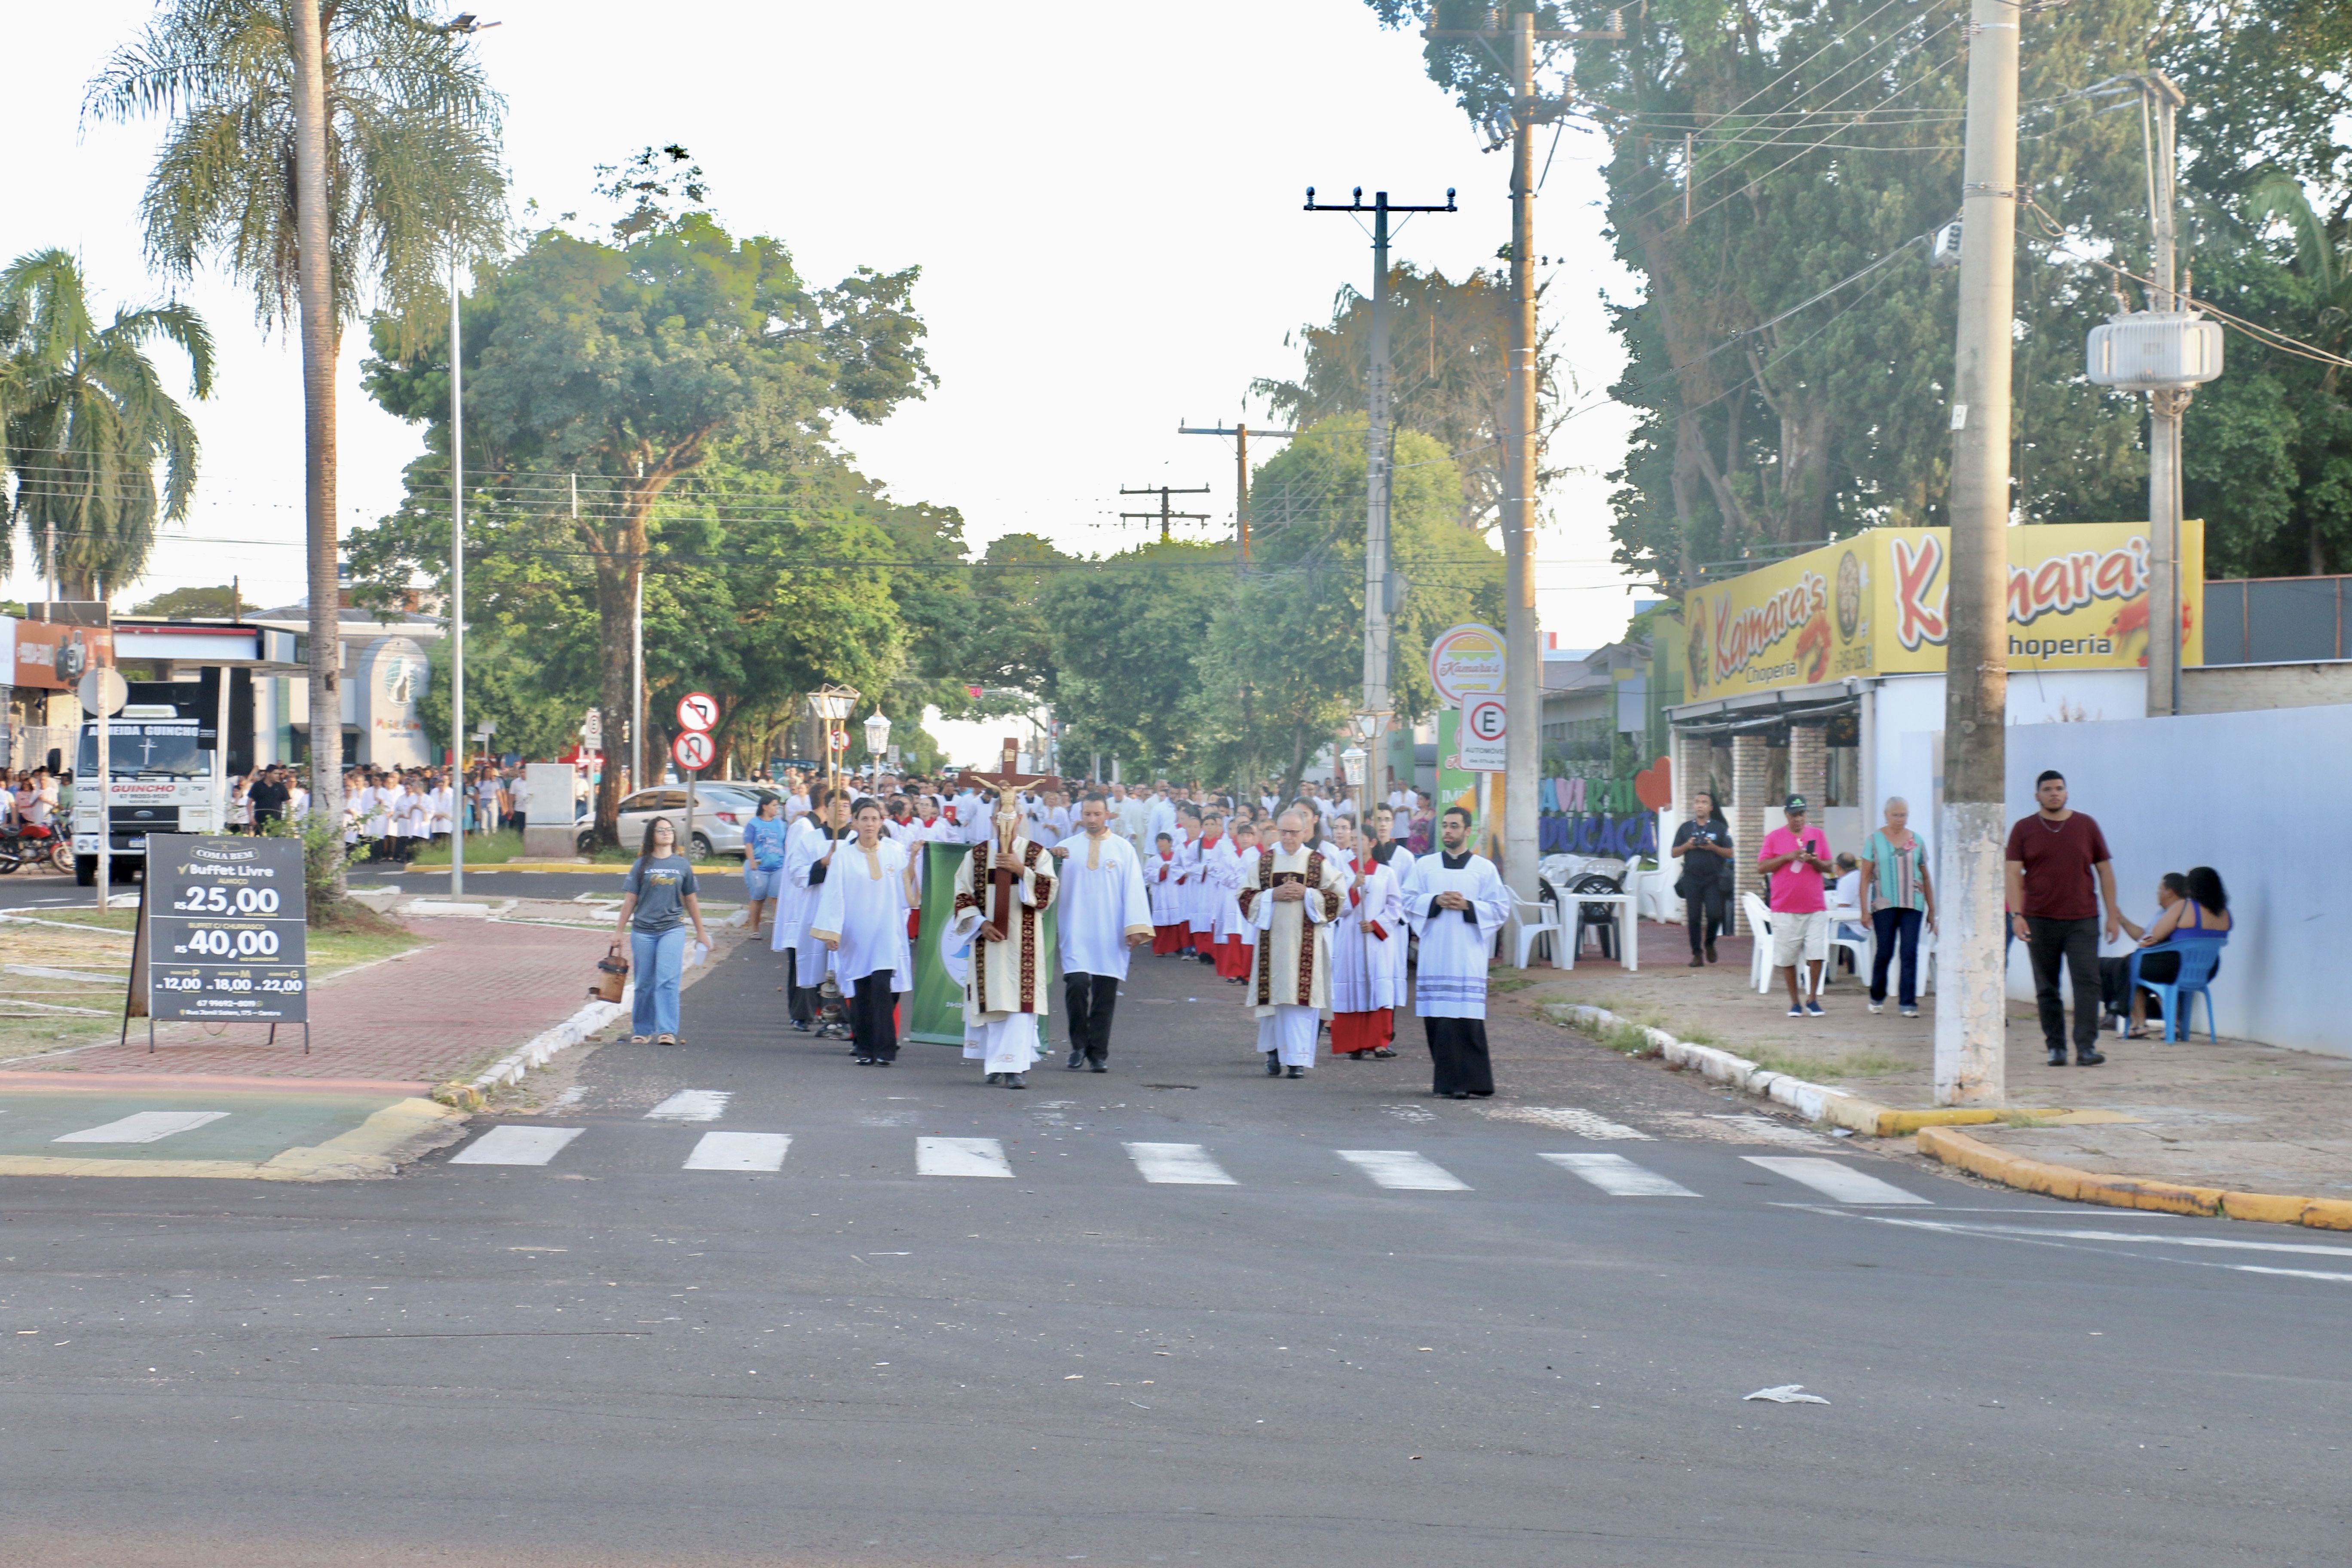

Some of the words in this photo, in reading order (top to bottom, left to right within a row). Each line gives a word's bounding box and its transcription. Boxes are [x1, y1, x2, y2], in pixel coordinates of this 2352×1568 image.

[1714, 570, 1827, 684] Kamara's
[2009, 635, 2113, 659] hoperia
[1439, 662, 1500, 677] Kamara's
[1747, 660, 1797, 684] Choperia
[144, 726, 199, 736] GUINCHO
[1483, 711, 1495, 732] E
[1539, 768, 1638, 813] AVIRAÍ
[1539, 812, 1658, 859] DUCAÇÃ
[196, 849, 229, 860] COMA
[230, 851, 254, 860] BEM
[190, 864, 236, 876] Buffet
[238, 866, 274, 877] Livre
[186, 886, 279, 916] 25,00
[188, 930, 279, 959] 40,00
[163, 978, 202, 990] 12,00
[214, 979, 252, 991] 18,00
[262, 980, 303, 992] 22,00
